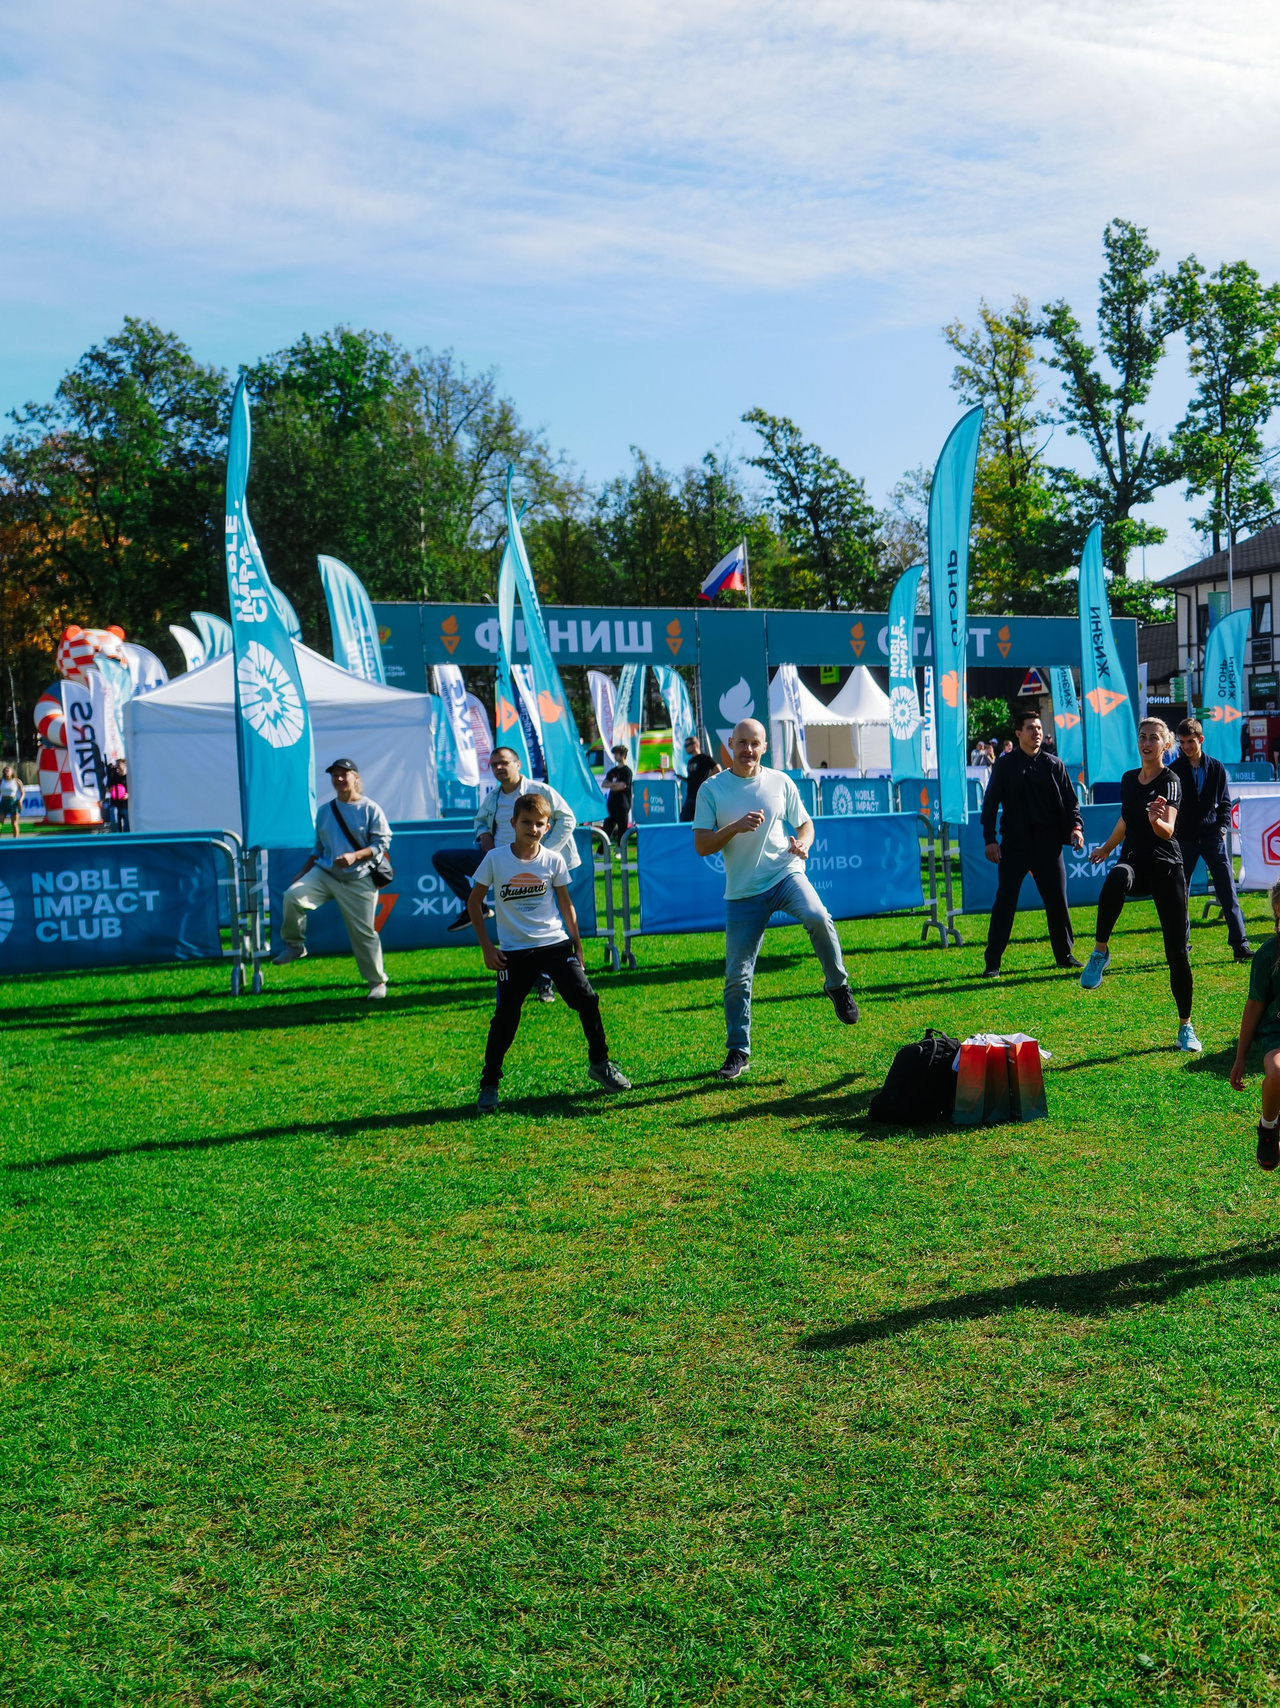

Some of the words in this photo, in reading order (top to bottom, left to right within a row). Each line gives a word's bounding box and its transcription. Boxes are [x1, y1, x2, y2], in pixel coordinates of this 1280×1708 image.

[238, 540, 258, 623] IMPA
[890, 625, 901, 678] NOBLE
[1089, 606, 1111, 678] ЖИЗНИ
[1060, 668, 1073, 708] ЖИЗНИ
[1218, 659, 1227, 698] ОГОНЬ
[1227, 656, 1236, 701] ЖИЗНИ
[1235, 772, 1255, 780] NOBLE
[855, 790, 875, 801] NOBLE
[855, 802, 879, 812] IMPACT
[31, 867, 139, 895] NOBLE
[33, 890, 160, 919] IMPACT
[35, 917, 123, 943] CLUB
